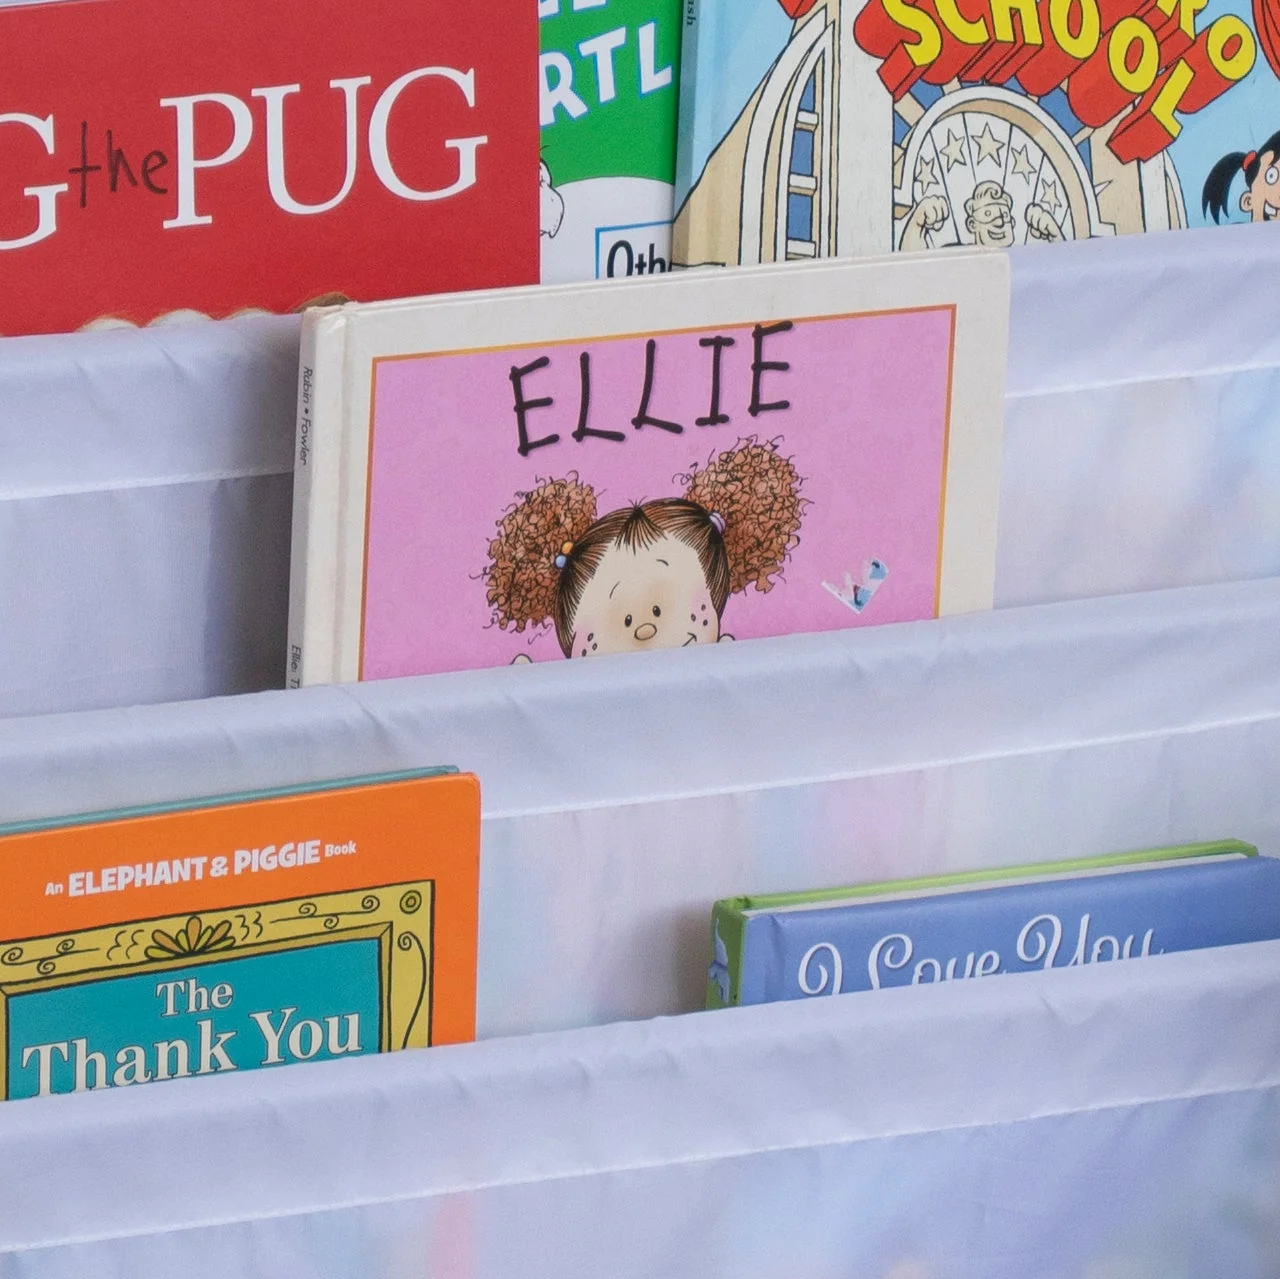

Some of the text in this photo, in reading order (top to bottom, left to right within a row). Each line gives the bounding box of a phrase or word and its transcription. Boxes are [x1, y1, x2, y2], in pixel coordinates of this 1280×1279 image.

[538, 21, 673, 128] RTL
[69, 120, 174, 209] the
[159, 66, 489, 230] PUG
[606, 239, 671, 278] Oth
[300, 366, 314, 466] Rubin Fowler
[508, 320, 795, 457] ELLIE
[45, 839, 357, 898] An ELEPHANT & PIGGIE Book
[154, 976, 234, 1018] The
[21, 1006, 364, 1098] Thank You
